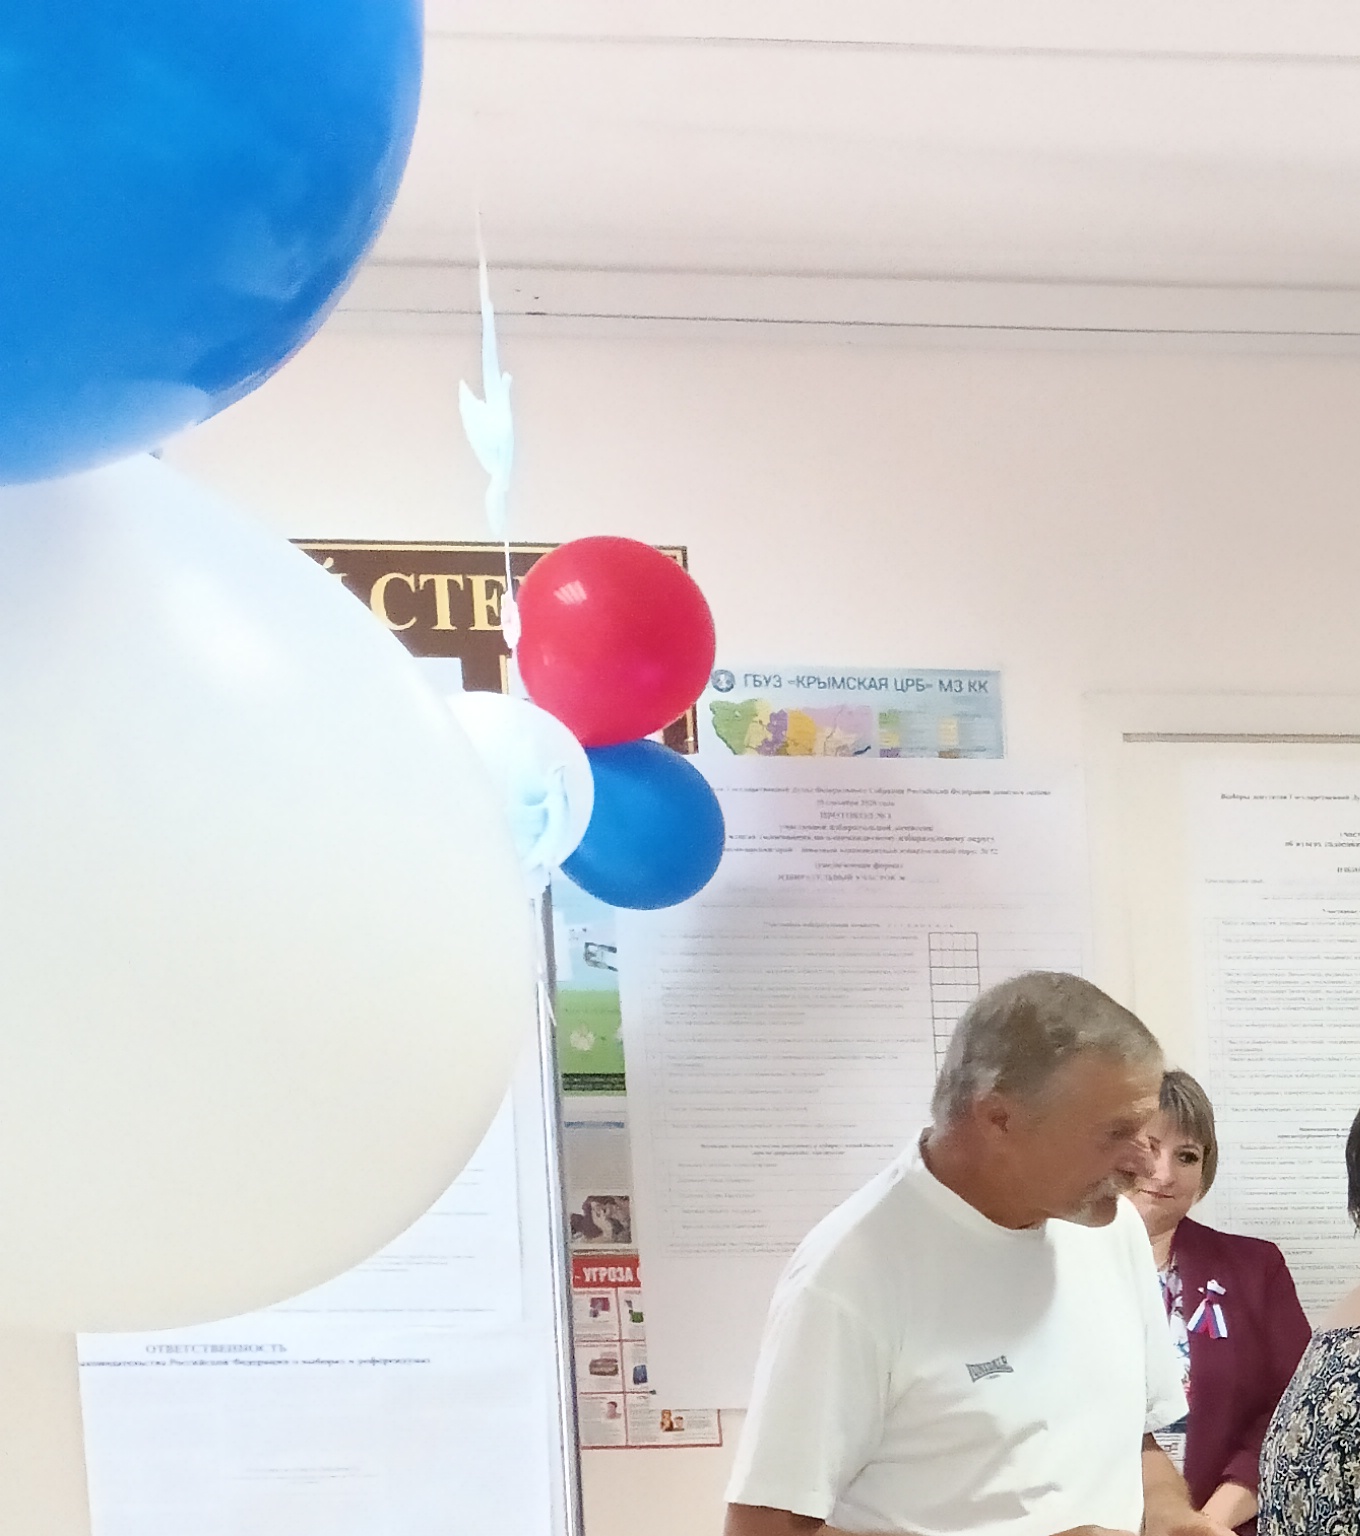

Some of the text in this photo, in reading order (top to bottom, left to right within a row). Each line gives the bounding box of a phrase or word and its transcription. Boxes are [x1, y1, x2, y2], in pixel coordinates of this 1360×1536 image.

[369, 571, 527, 631] СТЕ
[743, 673, 783, 688] ГБУЗ
[939, 679, 964, 693] МЗ
[968, 680, 989, 694] КК
[582, 1266, 634, 1283] УГРОЗА
